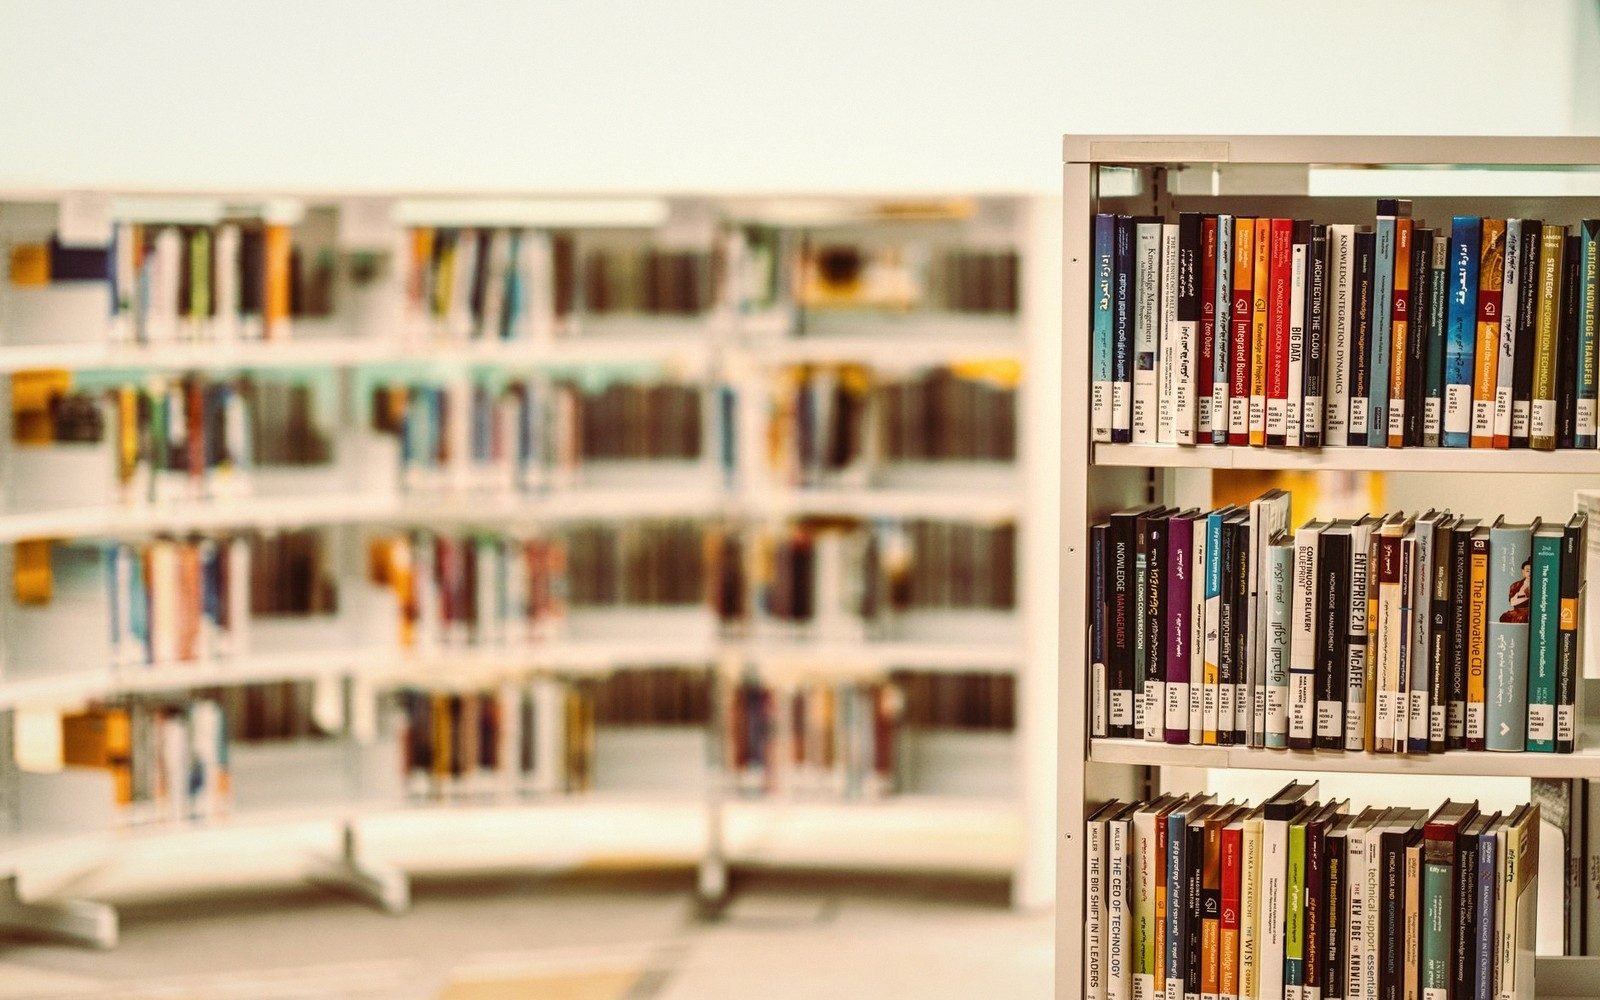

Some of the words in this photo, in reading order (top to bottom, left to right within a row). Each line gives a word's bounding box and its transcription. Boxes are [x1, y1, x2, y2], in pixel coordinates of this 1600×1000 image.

[1100, 255, 1110, 276] إدارة
[1145, 248, 1156, 290] Knowledge
[1339, 235, 1348, 288] KNOWLEDGE
[1587, 241, 1596, 280] CRITICAL
[1313, 259, 1322, 314] ARCHITECTING
[1456, 268, 1468, 304] المعرفة
[1545, 258, 1554, 298] STRATEGIC
[1100, 280, 1110, 310] المعرفة
[1586, 284, 1594, 336] KNOWLEDGE
[1145, 293, 1155, 343] Management
[1292, 327, 1301, 341] BIG
[1337, 290, 1346, 347] INTEGRATION
[1543, 300, 1552, 350] INFORMATION
[1202, 337, 1211, 358] Outage
[1235, 323, 1246, 364] Integrated
[1256, 323, 1264, 351] Knowledge
[1291, 343, 1300, 362] DATA
[1311, 333, 1320, 359] CLOUD
[1336, 350, 1344, 394] DYNAMICS
[1482, 362, 1490, 393] Knowledge
[1539, 352, 1550, 400] TECHNOLOGY
[1584, 340, 1593, 384] TRANSFER
[1236, 367, 1246, 394] Business
[1116, 543, 1125, 591] KNOWLEDGE
[1274, 562, 1284, 582] مايكل
[1306, 546, 1314, 596] CONTINUOUS
[1353, 553, 1367, 612] ENTERPRISE
[1473, 579, 1483, 598] The
[1116, 594, 1124, 649] MANAGEMENT
[1271, 622, 1286, 645] الروح
[1352, 615, 1364, 630] 2.0
[1472, 601, 1483, 655] Innovative
[1539, 614, 1547, 644] Manager's
[1350, 649, 1363, 688] McAFEE
[1472, 658, 1481, 676] CIO
[1562, 653, 1570, 676] Technology
[1091, 857, 1099, 876] THE
[1113, 857, 1121, 876] THE
[1330, 859, 1338, 879] Digital
[1112, 878, 1121, 897] CEO
[1368, 868, 1377, 912] technical
[1112, 900, 1121, 912] OF
[1352, 899, 1361, 915] NEW
[1091, 923, 1098, 932] IN
[1091, 935, 1098, 944] IT
[1352, 921, 1361, 941] EDGE
[1366, 915, 1376, 952] support
[1111, 915, 1120, 978] TECHNOLOGY
[1223, 932, 1234, 970] Knowledge
[1244, 940, 1253, 966] WISE
[1090, 946, 1098, 987] LEADERS
[1366, 955, 1375, 1000] essentials
